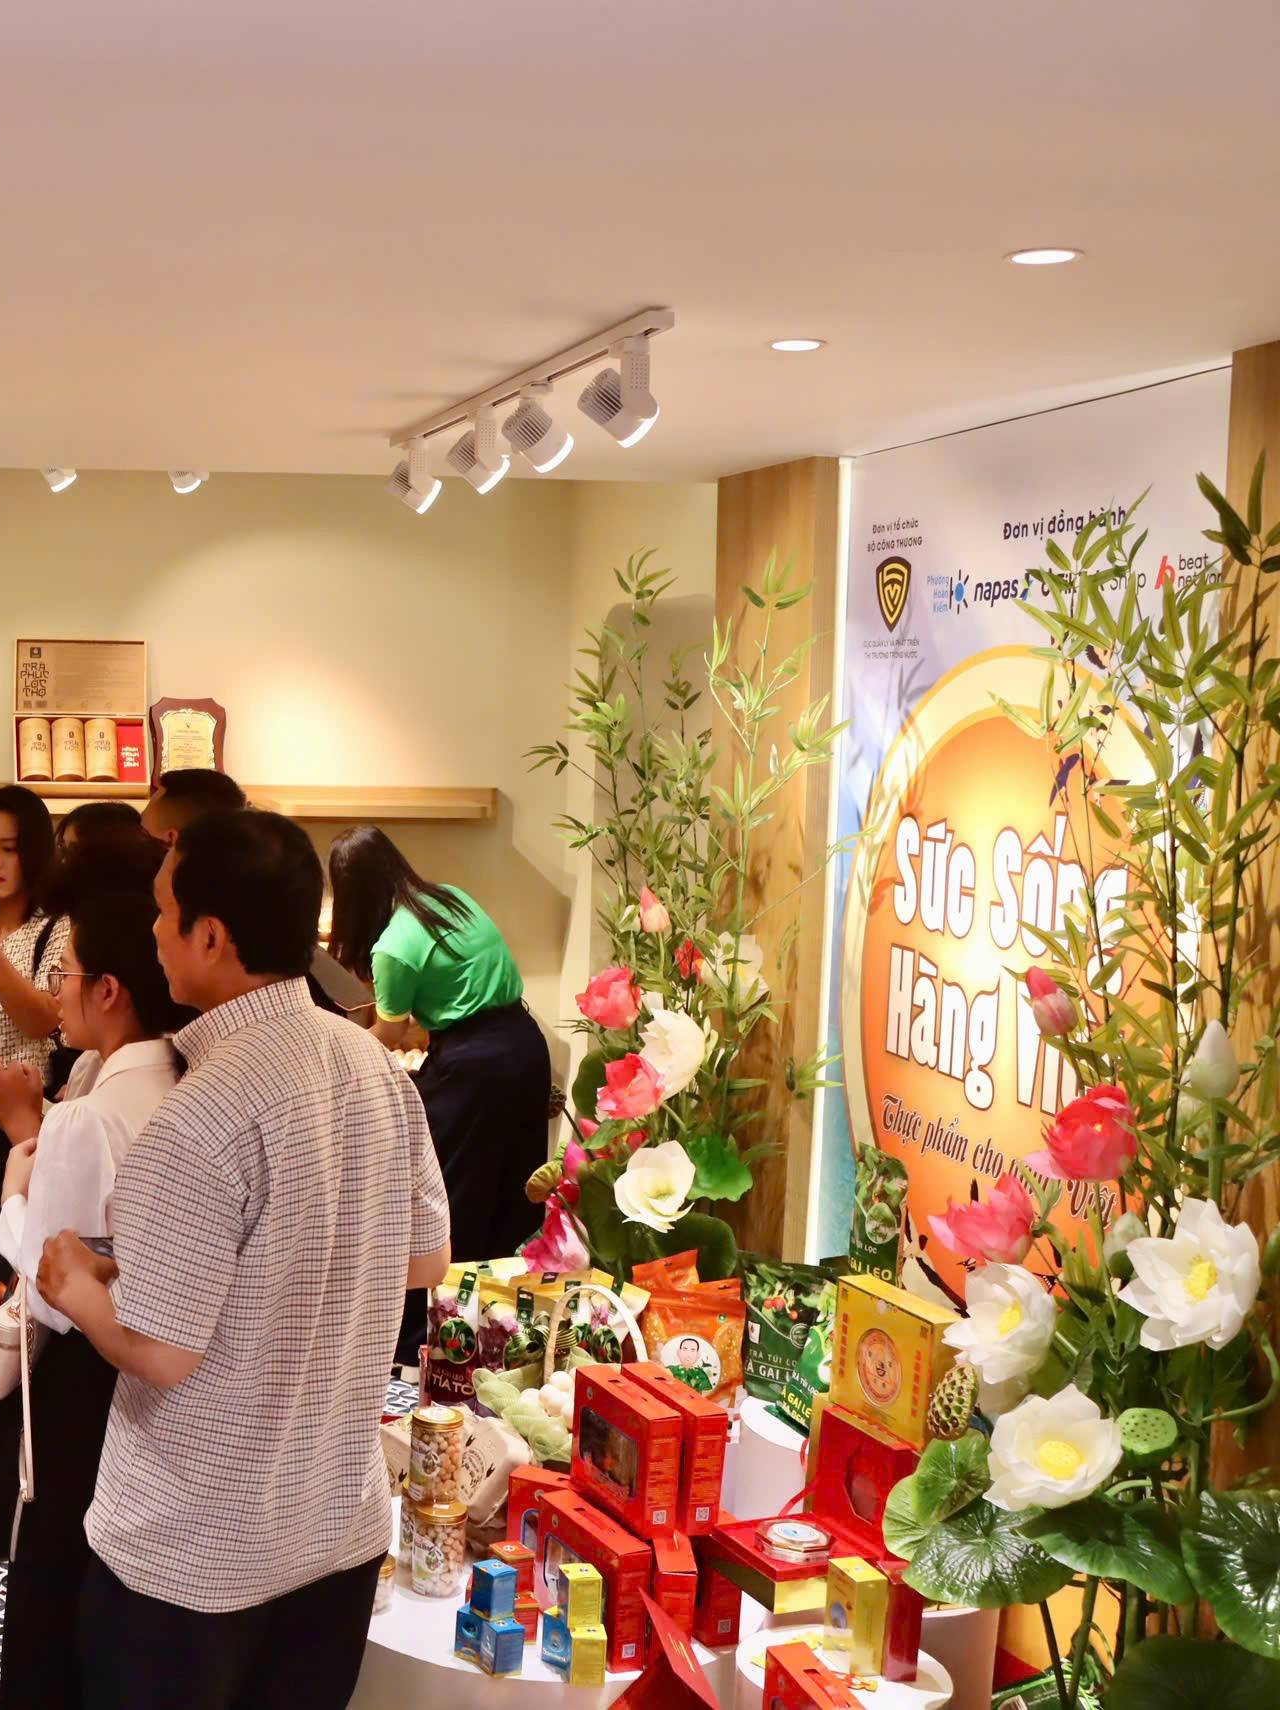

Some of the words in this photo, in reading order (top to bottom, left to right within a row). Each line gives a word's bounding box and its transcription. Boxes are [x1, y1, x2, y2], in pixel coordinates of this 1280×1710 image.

[1003, 522, 1028, 540] Đơn
[1032, 517, 1044, 540] vị
[1047, 509, 1084, 536] đồng
[1178, 553, 1209, 571] beat
[974, 579, 1018, 607] napas
[1110, 571, 1147, 595] Shp
[892, 812, 976, 940] Sức
[989, 812, 1129, 998] Sống
[885, 943, 1001, 1112] Hàng
[882, 1094, 921, 1144] Thực
[921, 1117, 969, 1163] phẩm
[971, 1138, 1004, 1179] cho
[866, 1264, 893, 1281] LEO
[432, 1373, 452, 1392] TÍA
[759, 1364, 780, 1381] GAI
[787, 1393, 802, 1409] GAI
